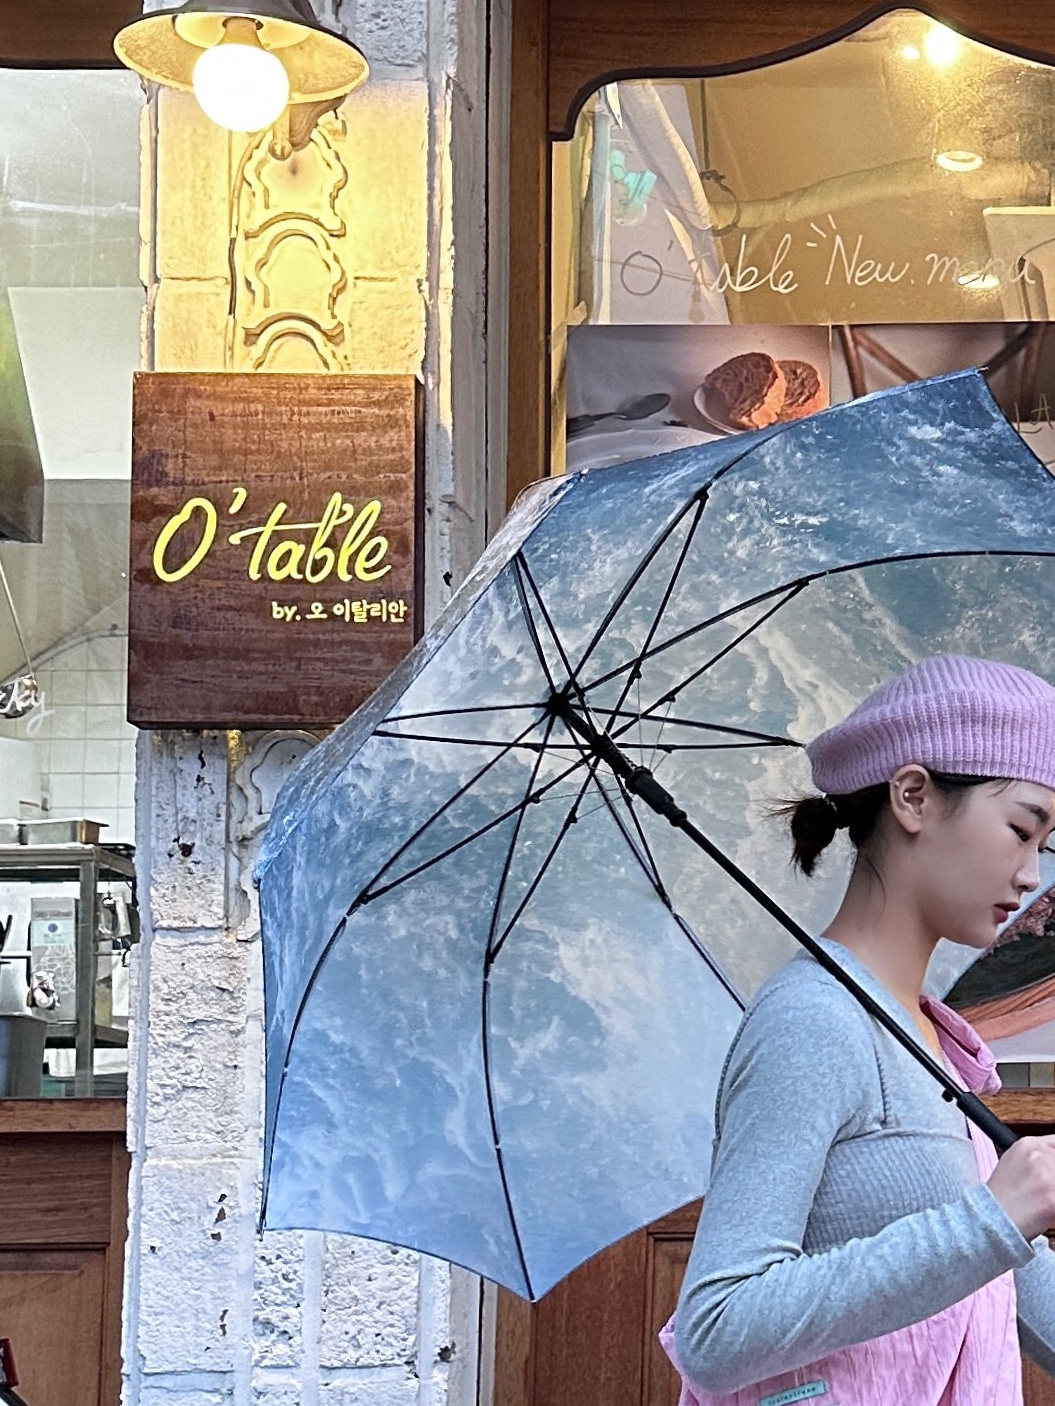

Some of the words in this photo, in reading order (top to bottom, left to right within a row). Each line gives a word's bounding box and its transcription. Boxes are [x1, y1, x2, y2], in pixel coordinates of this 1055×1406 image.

[924, 252, 1036, 286] menu
[271, 600, 301, 622] by.
[305, 601, 328, 619] 오
[332, 598, 408, 623] 이탈리안
